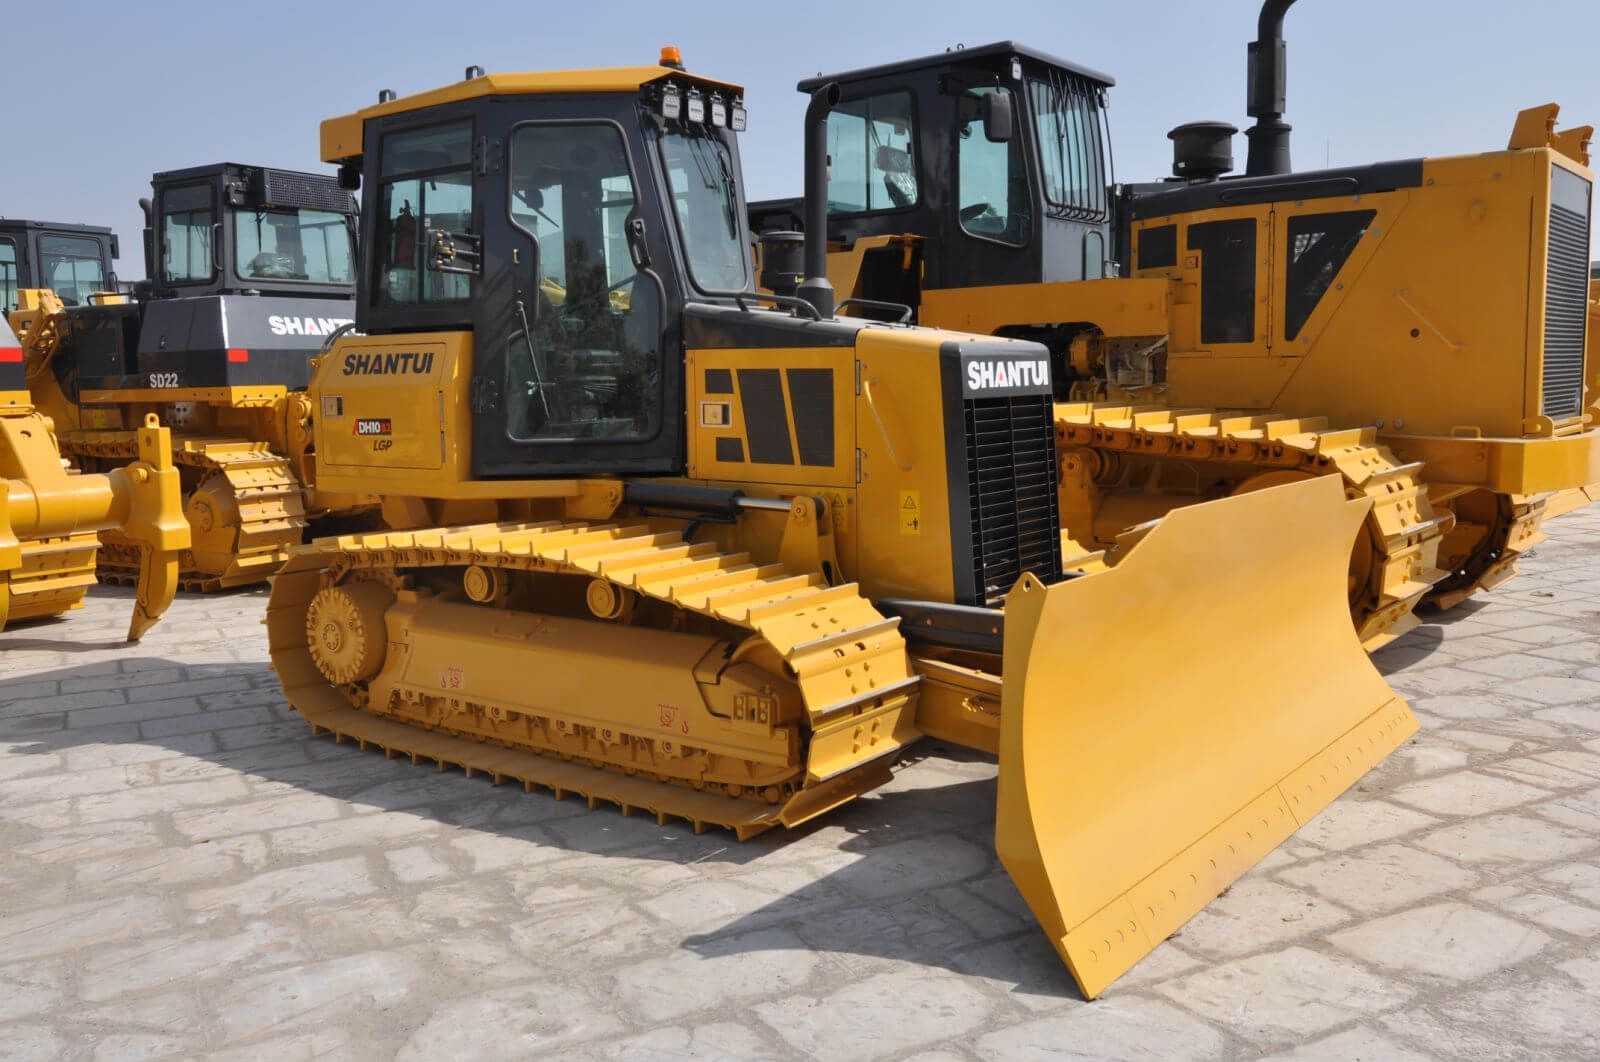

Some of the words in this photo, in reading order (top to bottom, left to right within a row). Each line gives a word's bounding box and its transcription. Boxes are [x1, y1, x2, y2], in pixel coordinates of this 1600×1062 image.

[268, 315, 366, 335] SHANT
[342, 352, 434, 376] SHANTUI
[150, 373, 179, 388] SD22
[967, 361, 1049, 390] SHANTUI
[373, 439, 393, 452] LGP
